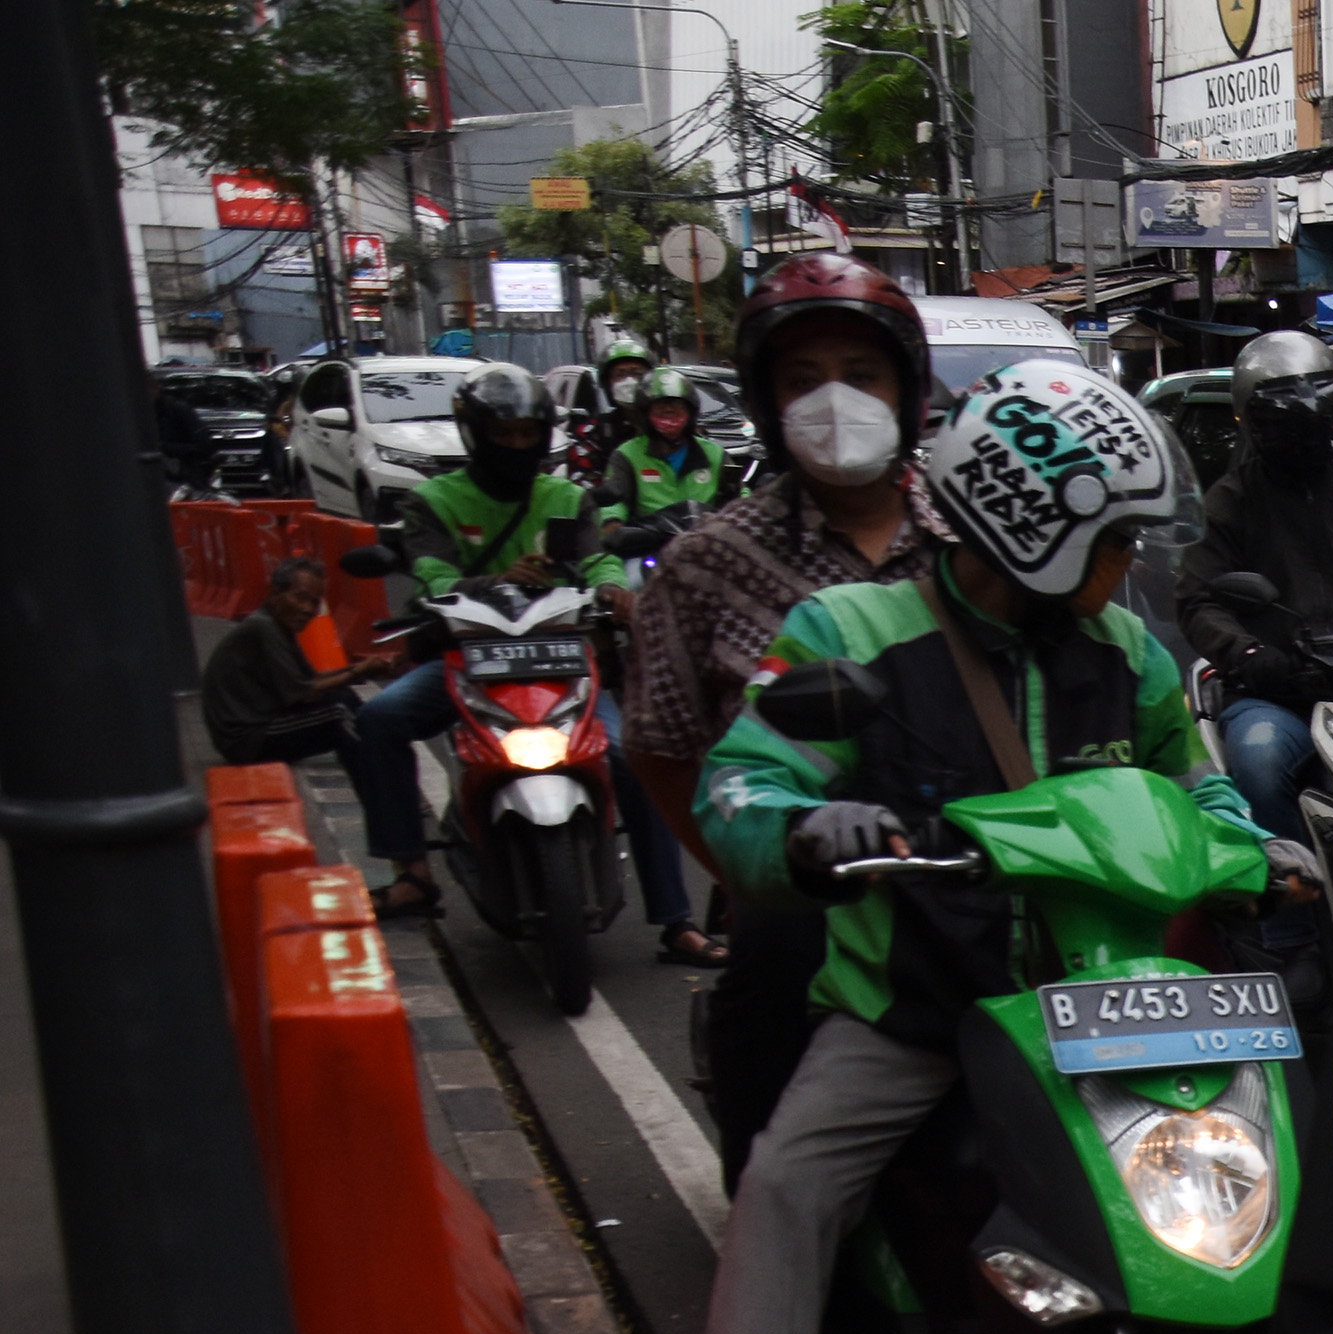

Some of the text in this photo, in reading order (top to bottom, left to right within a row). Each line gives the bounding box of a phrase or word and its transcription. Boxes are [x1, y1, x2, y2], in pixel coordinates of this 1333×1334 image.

[1205, 63, 1280, 109] KOSGORO
[1240, 102, 1280, 131] KOLEKTIF
[1244, 131, 1279, 158] IBUKOTA
[1006, 330, 1054, 339] TRANS
[953, 457, 1050, 555] RIDE
[1051, 983, 1281, 1028] B 4453 SXU
